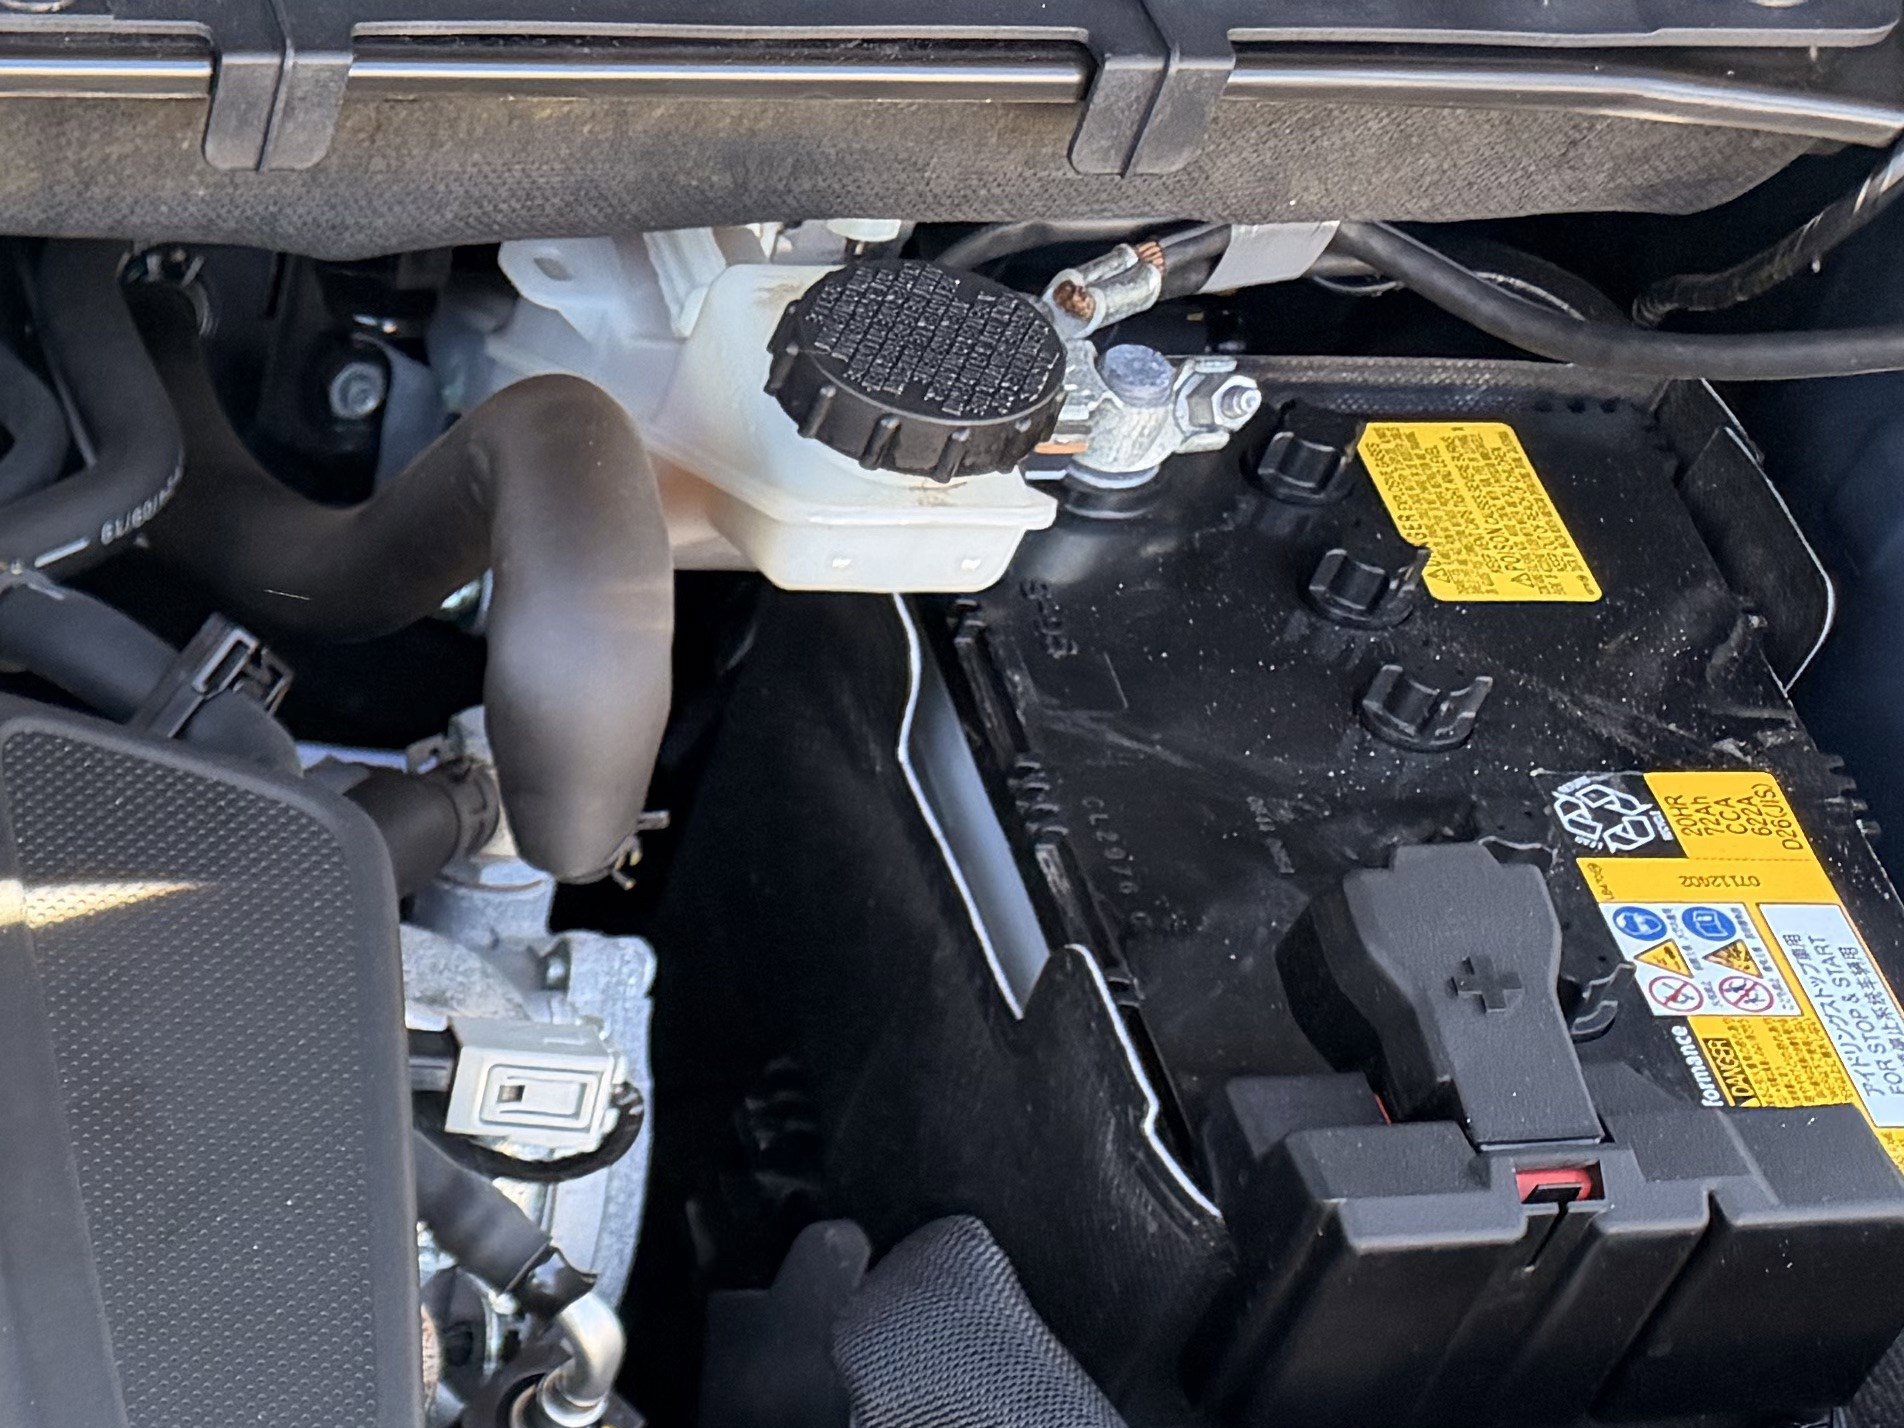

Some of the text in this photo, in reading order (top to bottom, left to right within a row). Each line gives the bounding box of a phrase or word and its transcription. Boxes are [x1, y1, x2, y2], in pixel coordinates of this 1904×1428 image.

[1664, 795, 1704, 837] 20HR
[1690, 796, 1726, 836] 72Ah
[1714, 797, 1749, 834] CCA
[1736, 796, 1774, 837] 622A
[1751, 783, 1804, 851] D26(JIS)
[1807, 934, 1851, 989] START
[1849, 1008, 1886, 1056] STOP
[1707, 1039, 1754, 1098] DANGER
